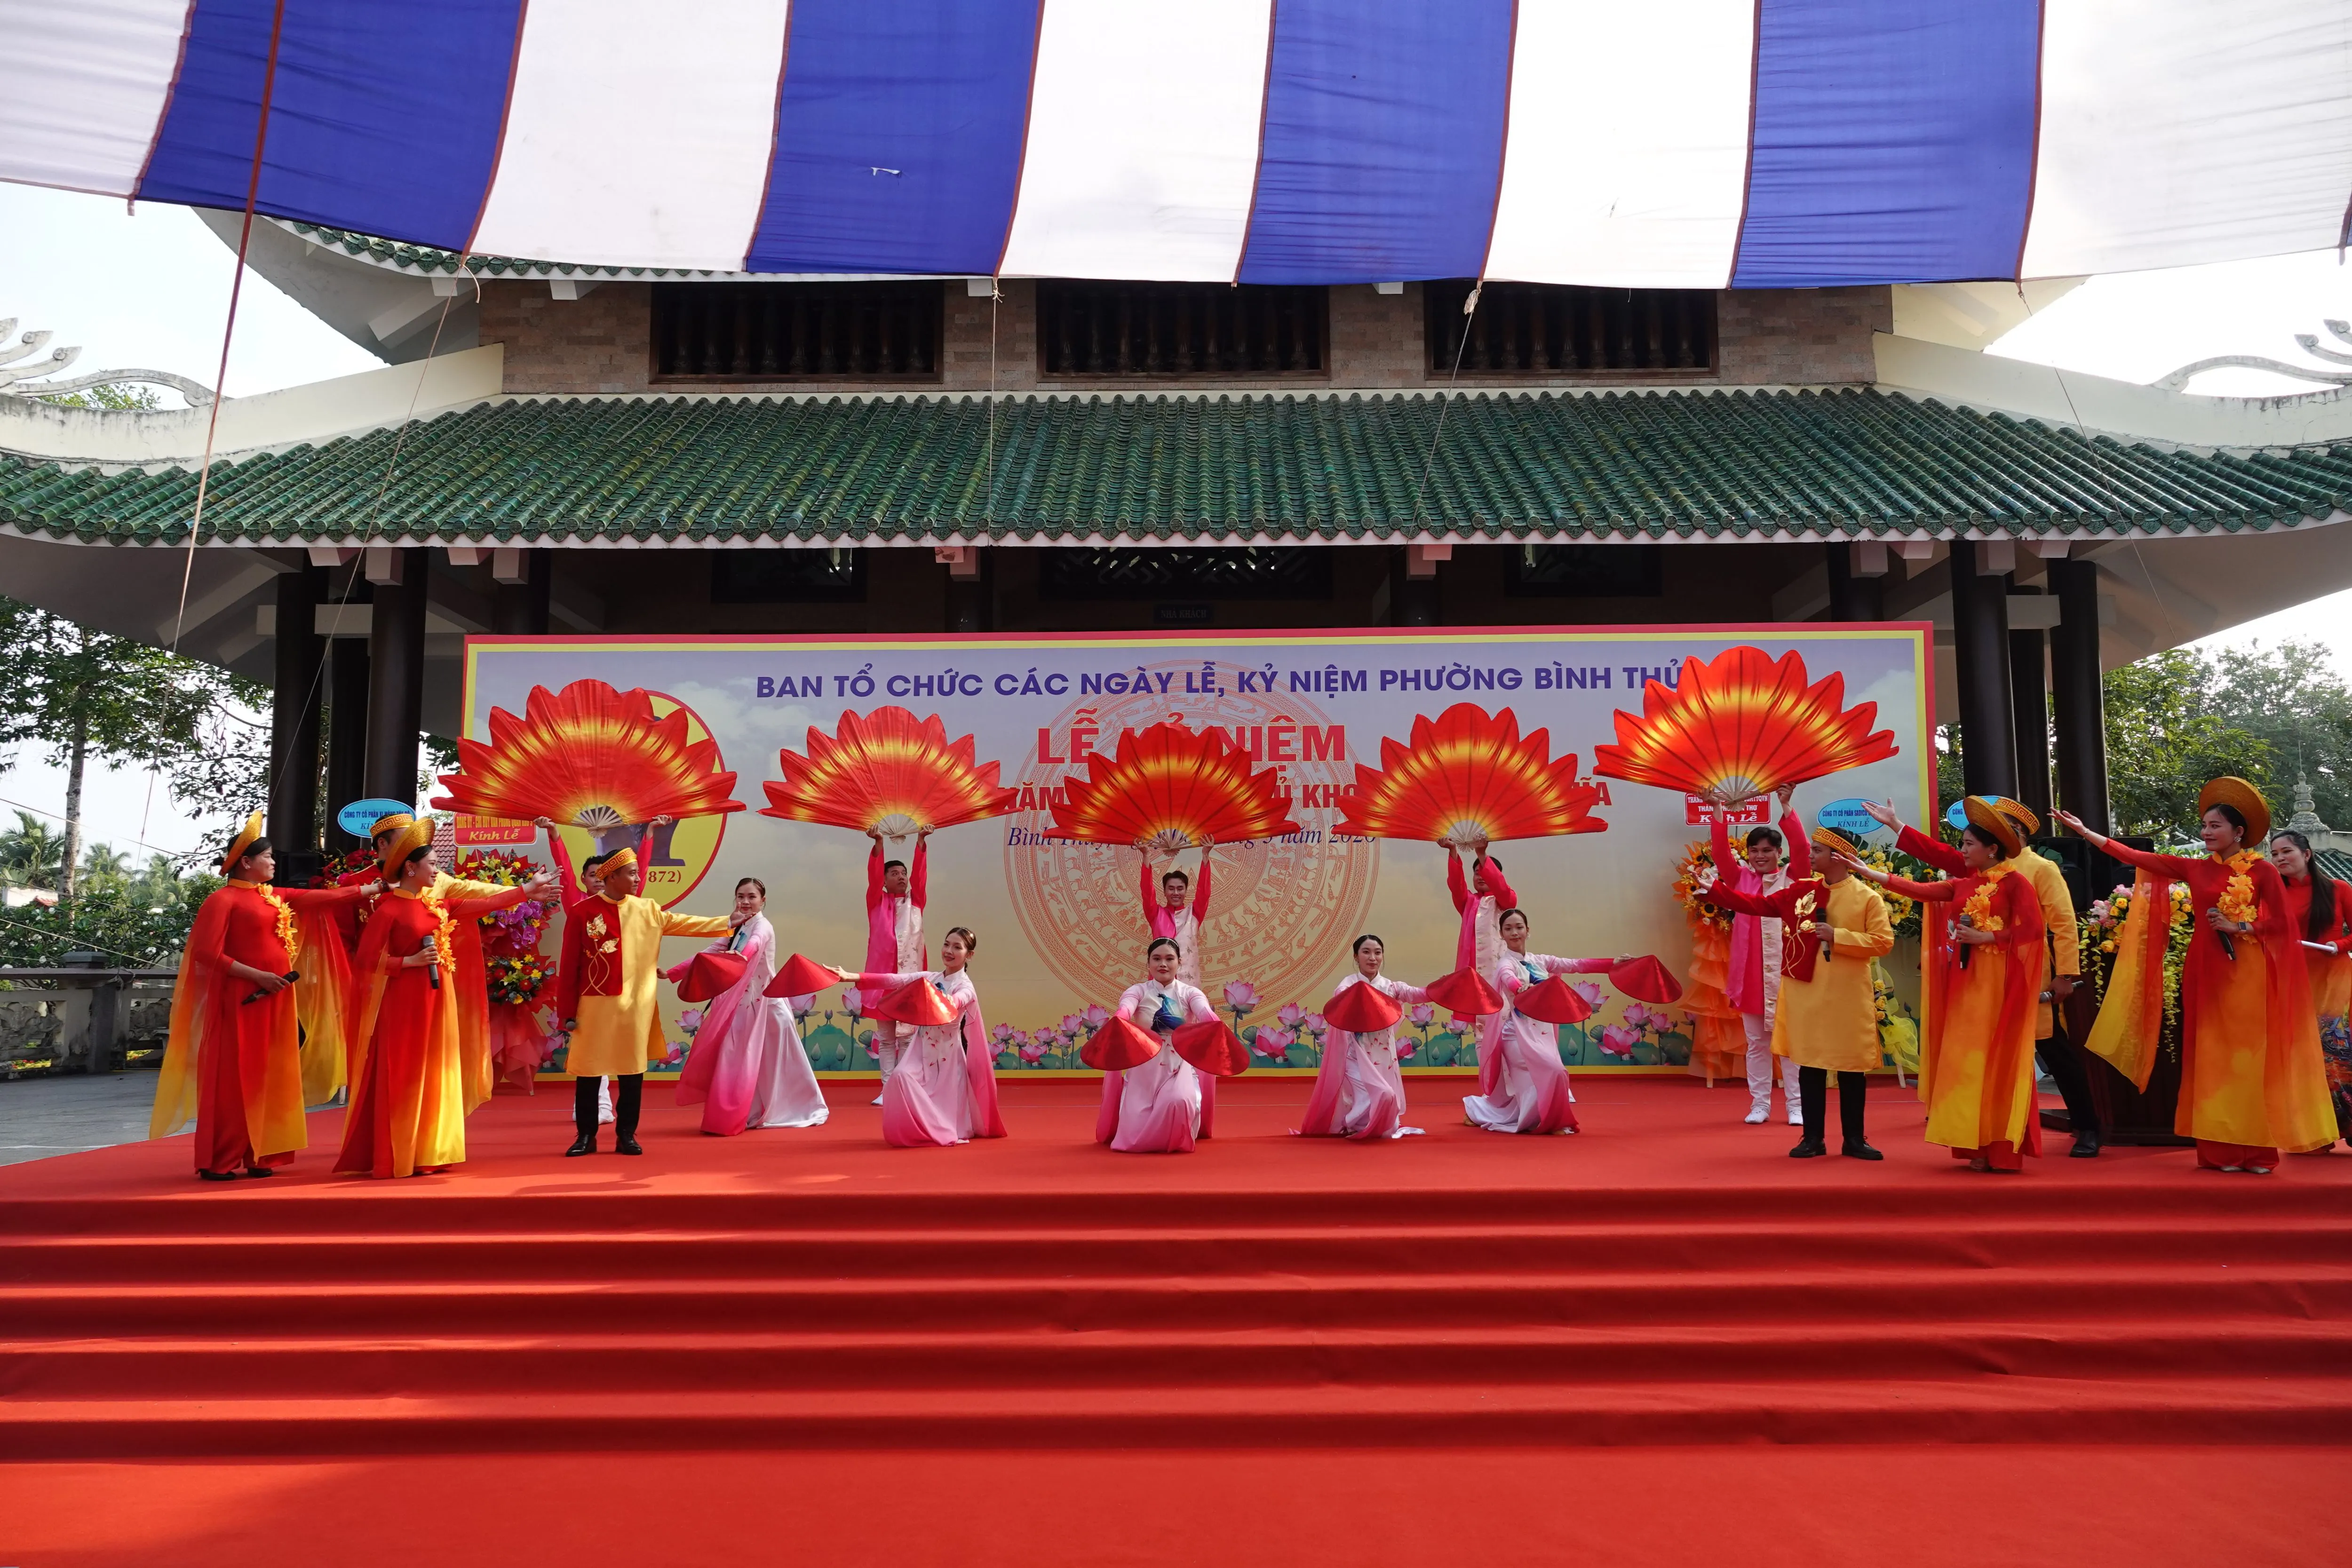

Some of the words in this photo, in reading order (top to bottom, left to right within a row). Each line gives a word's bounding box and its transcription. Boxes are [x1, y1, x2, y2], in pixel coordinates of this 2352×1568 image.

[756, 676, 822, 698] BAN
[834, 663, 875, 697] TỔ
[887, 668, 983, 697] CHỨC
[994, 667, 1069, 696] CÁC
[1081, 666, 1172, 695] NGÀY
[1186, 661, 1224, 697] LỄ,
[1238, 662, 1279, 693] KỶ
[1289, 663, 1367, 699] NIỆM
[1380, 661, 1523, 691] PHƯỜNG
[1535, 660, 1611, 690] BÌNH
[1622, 658, 1683, 689] THỦ
[1038, 707, 1100, 764] LỄ
[1212, 714, 1346, 772] NIỆM
[1739, 812, 1757, 822] Lễ
[1859, 817, 1870, 827] LỄ
[469, 831, 501, 841] Kính
[504, 828, 520, 840] Lễ
